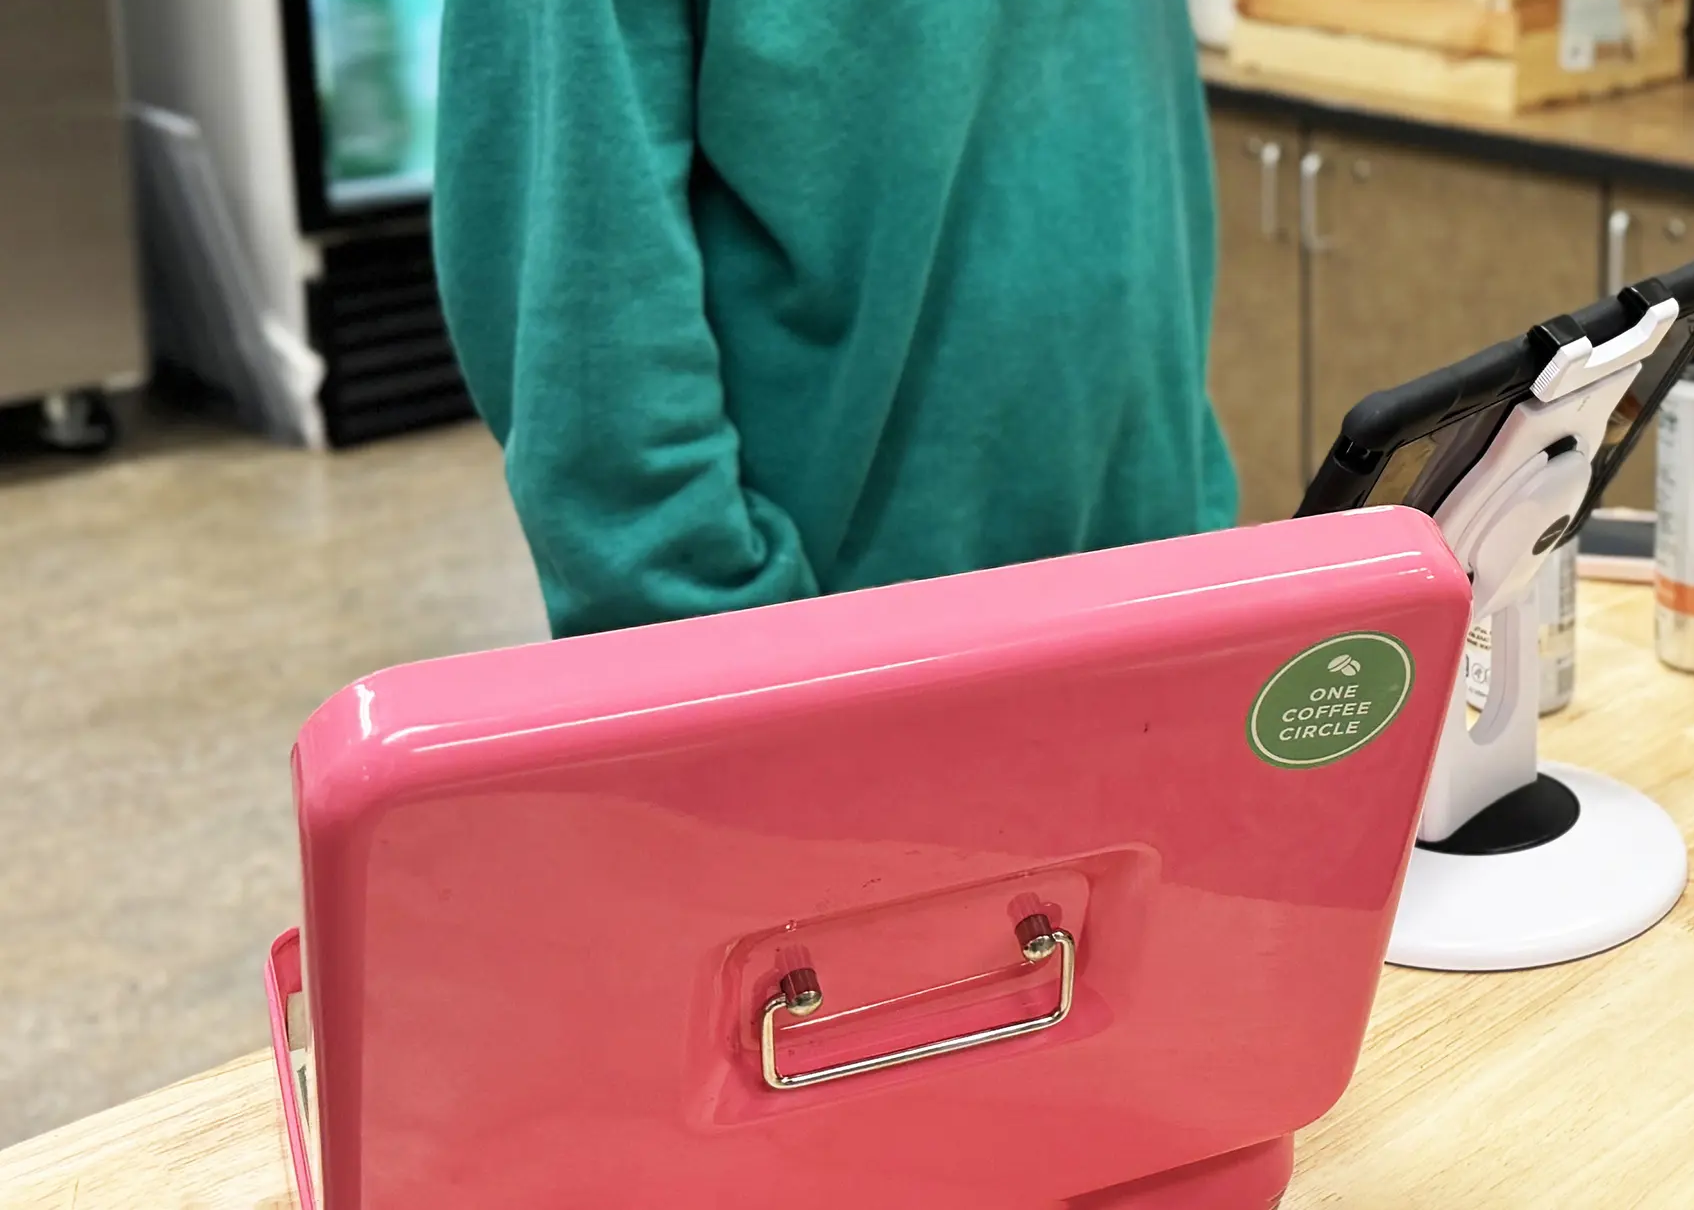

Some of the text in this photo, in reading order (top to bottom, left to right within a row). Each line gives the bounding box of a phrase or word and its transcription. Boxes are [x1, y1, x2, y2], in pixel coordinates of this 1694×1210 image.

[1310, 684, 1359, 702] ONE
[1281, 701, 1372, 723] COFFEE
[1279, 721, 1361, 741] CIRCLE
